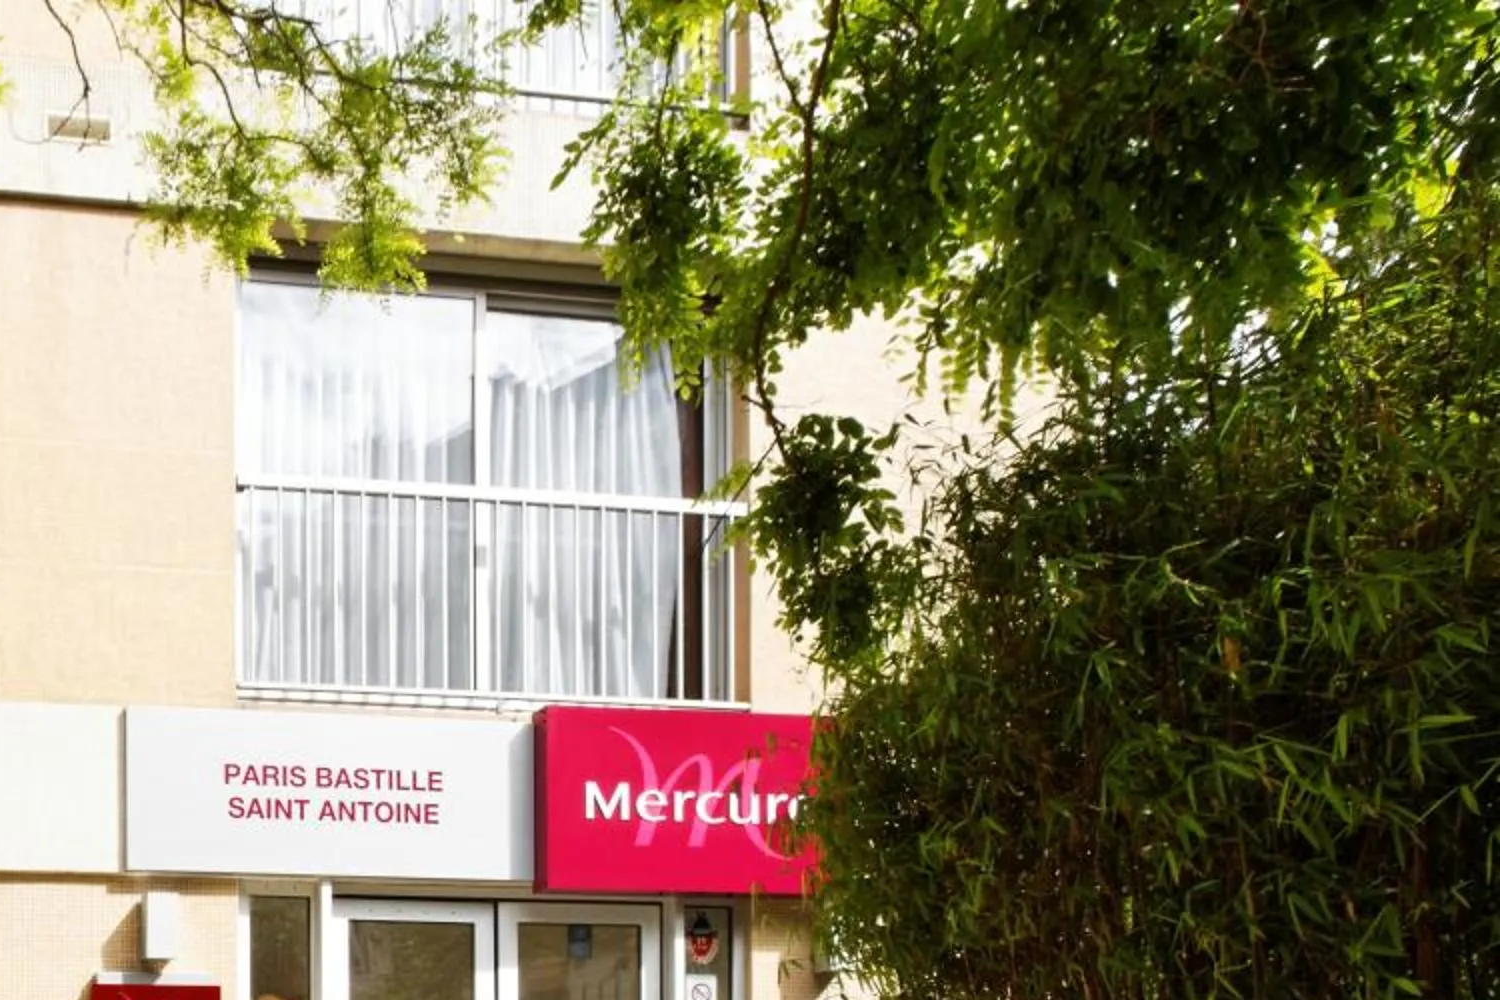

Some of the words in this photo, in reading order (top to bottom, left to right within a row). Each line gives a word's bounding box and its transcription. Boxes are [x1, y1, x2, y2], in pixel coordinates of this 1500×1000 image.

[223, 763, 308, 788] PARIS
[315, 766, 444, 792] BASTILLE
[228, 796, 310, 822] SAINT
[318, 800, 440, 825] ANTOINE
